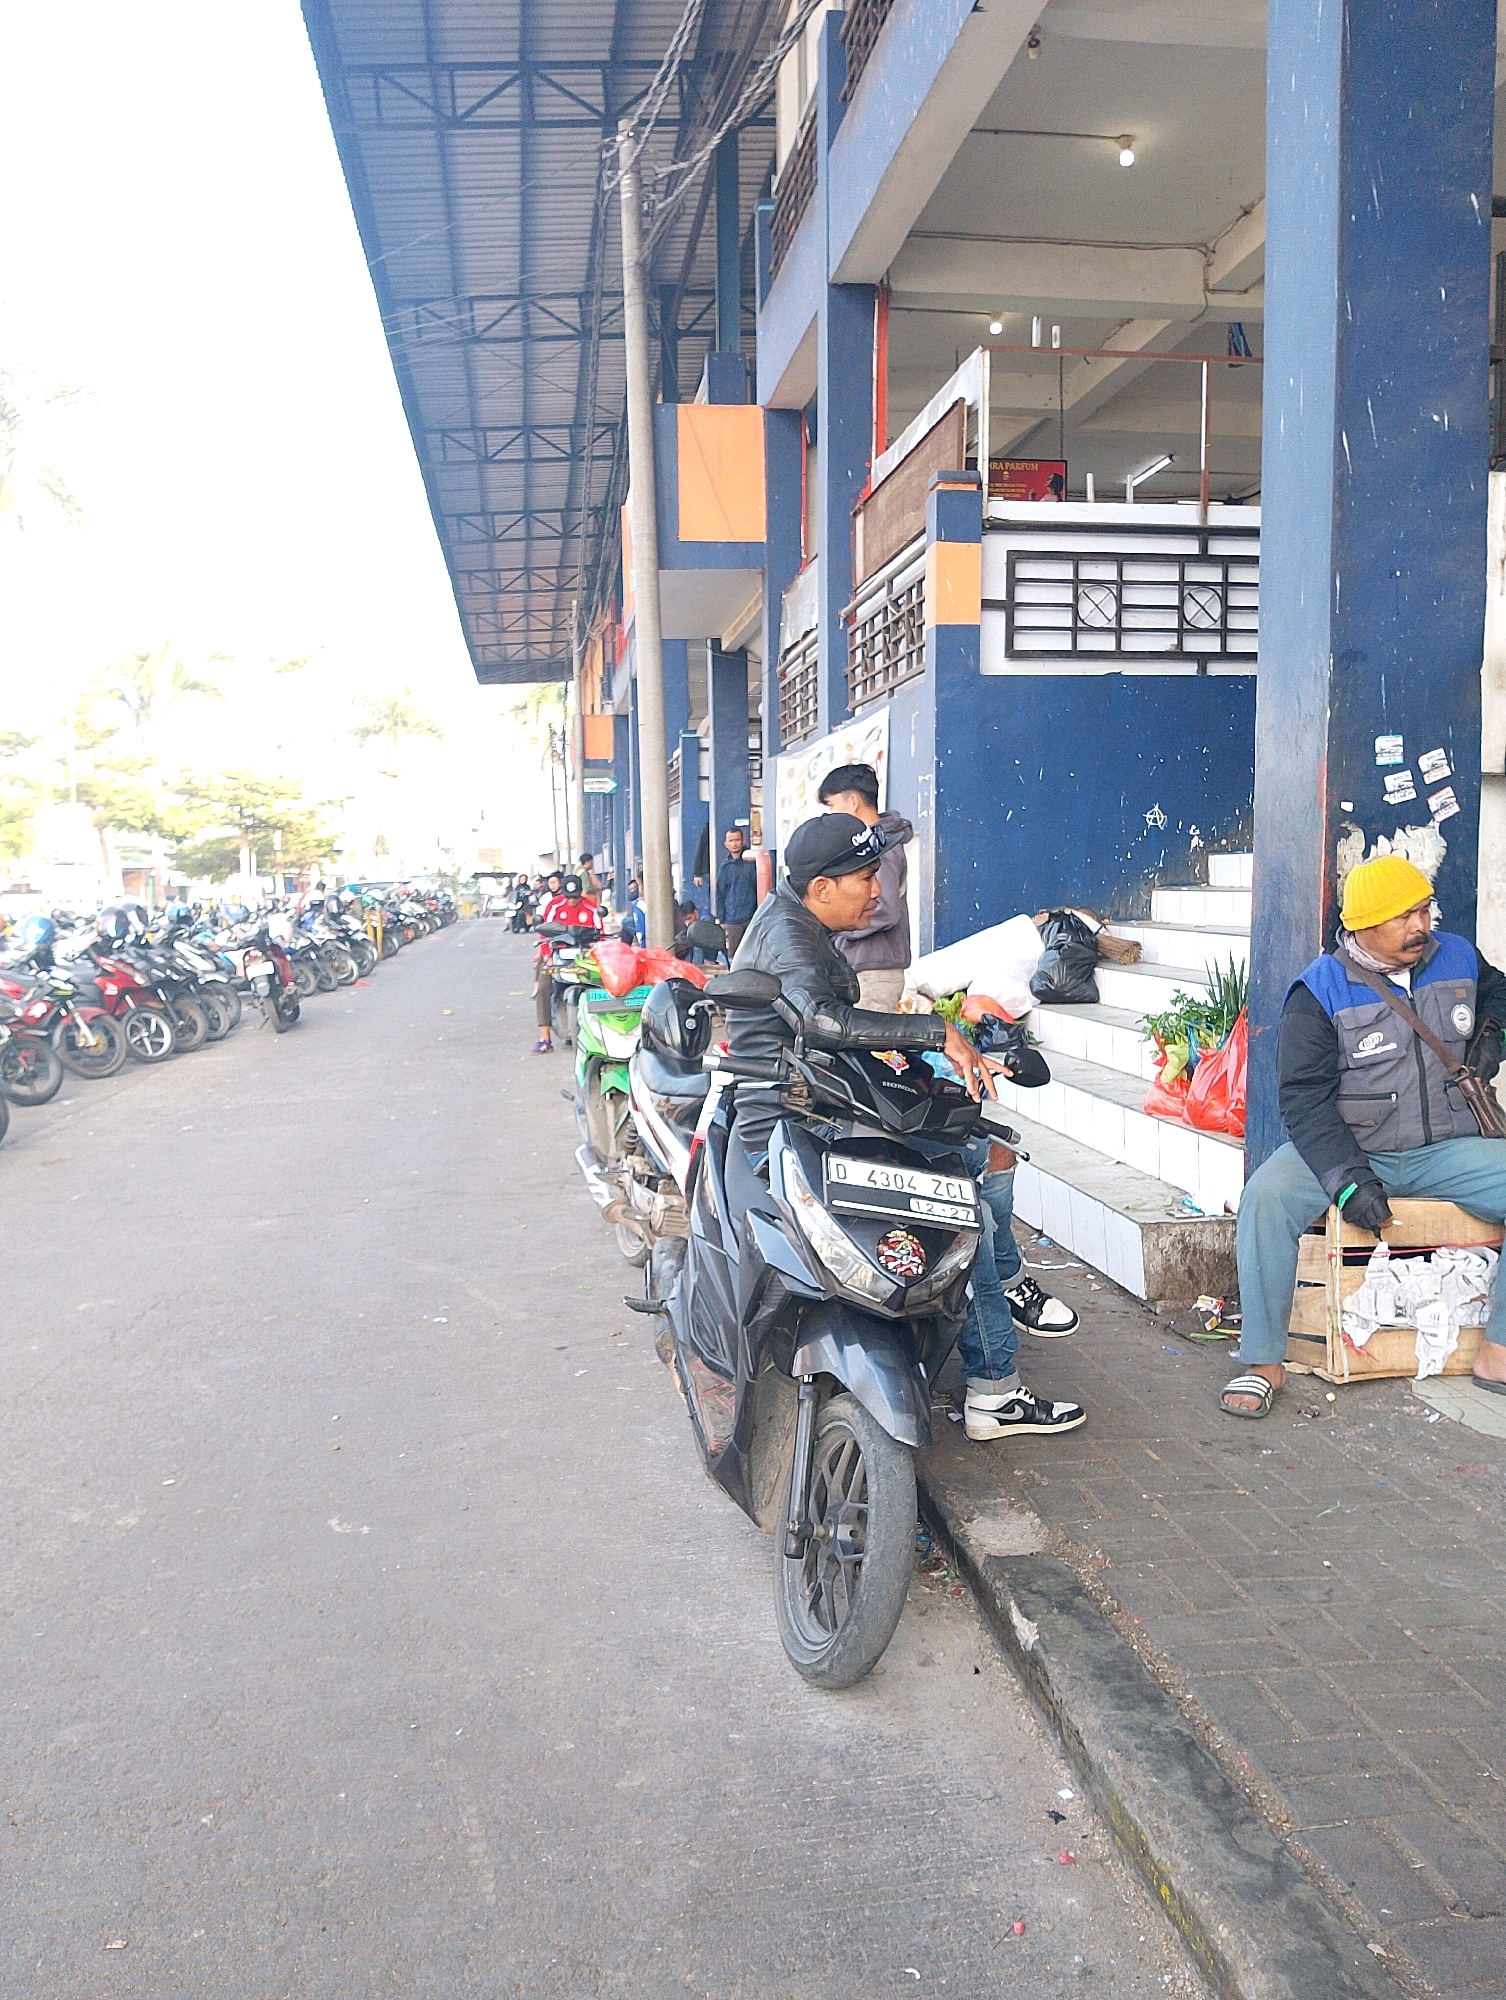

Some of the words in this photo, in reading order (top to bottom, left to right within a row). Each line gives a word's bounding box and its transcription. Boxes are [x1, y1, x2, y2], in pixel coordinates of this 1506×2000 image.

[1004, 462, 1039, 471] PARFUM
[881, 1081, 918, 1095] HONDA
[836, 1163, 847, 1180] D
[867, 1169, 917, 1192] 4304
[931, 1178, 971, 1201] ZCL
